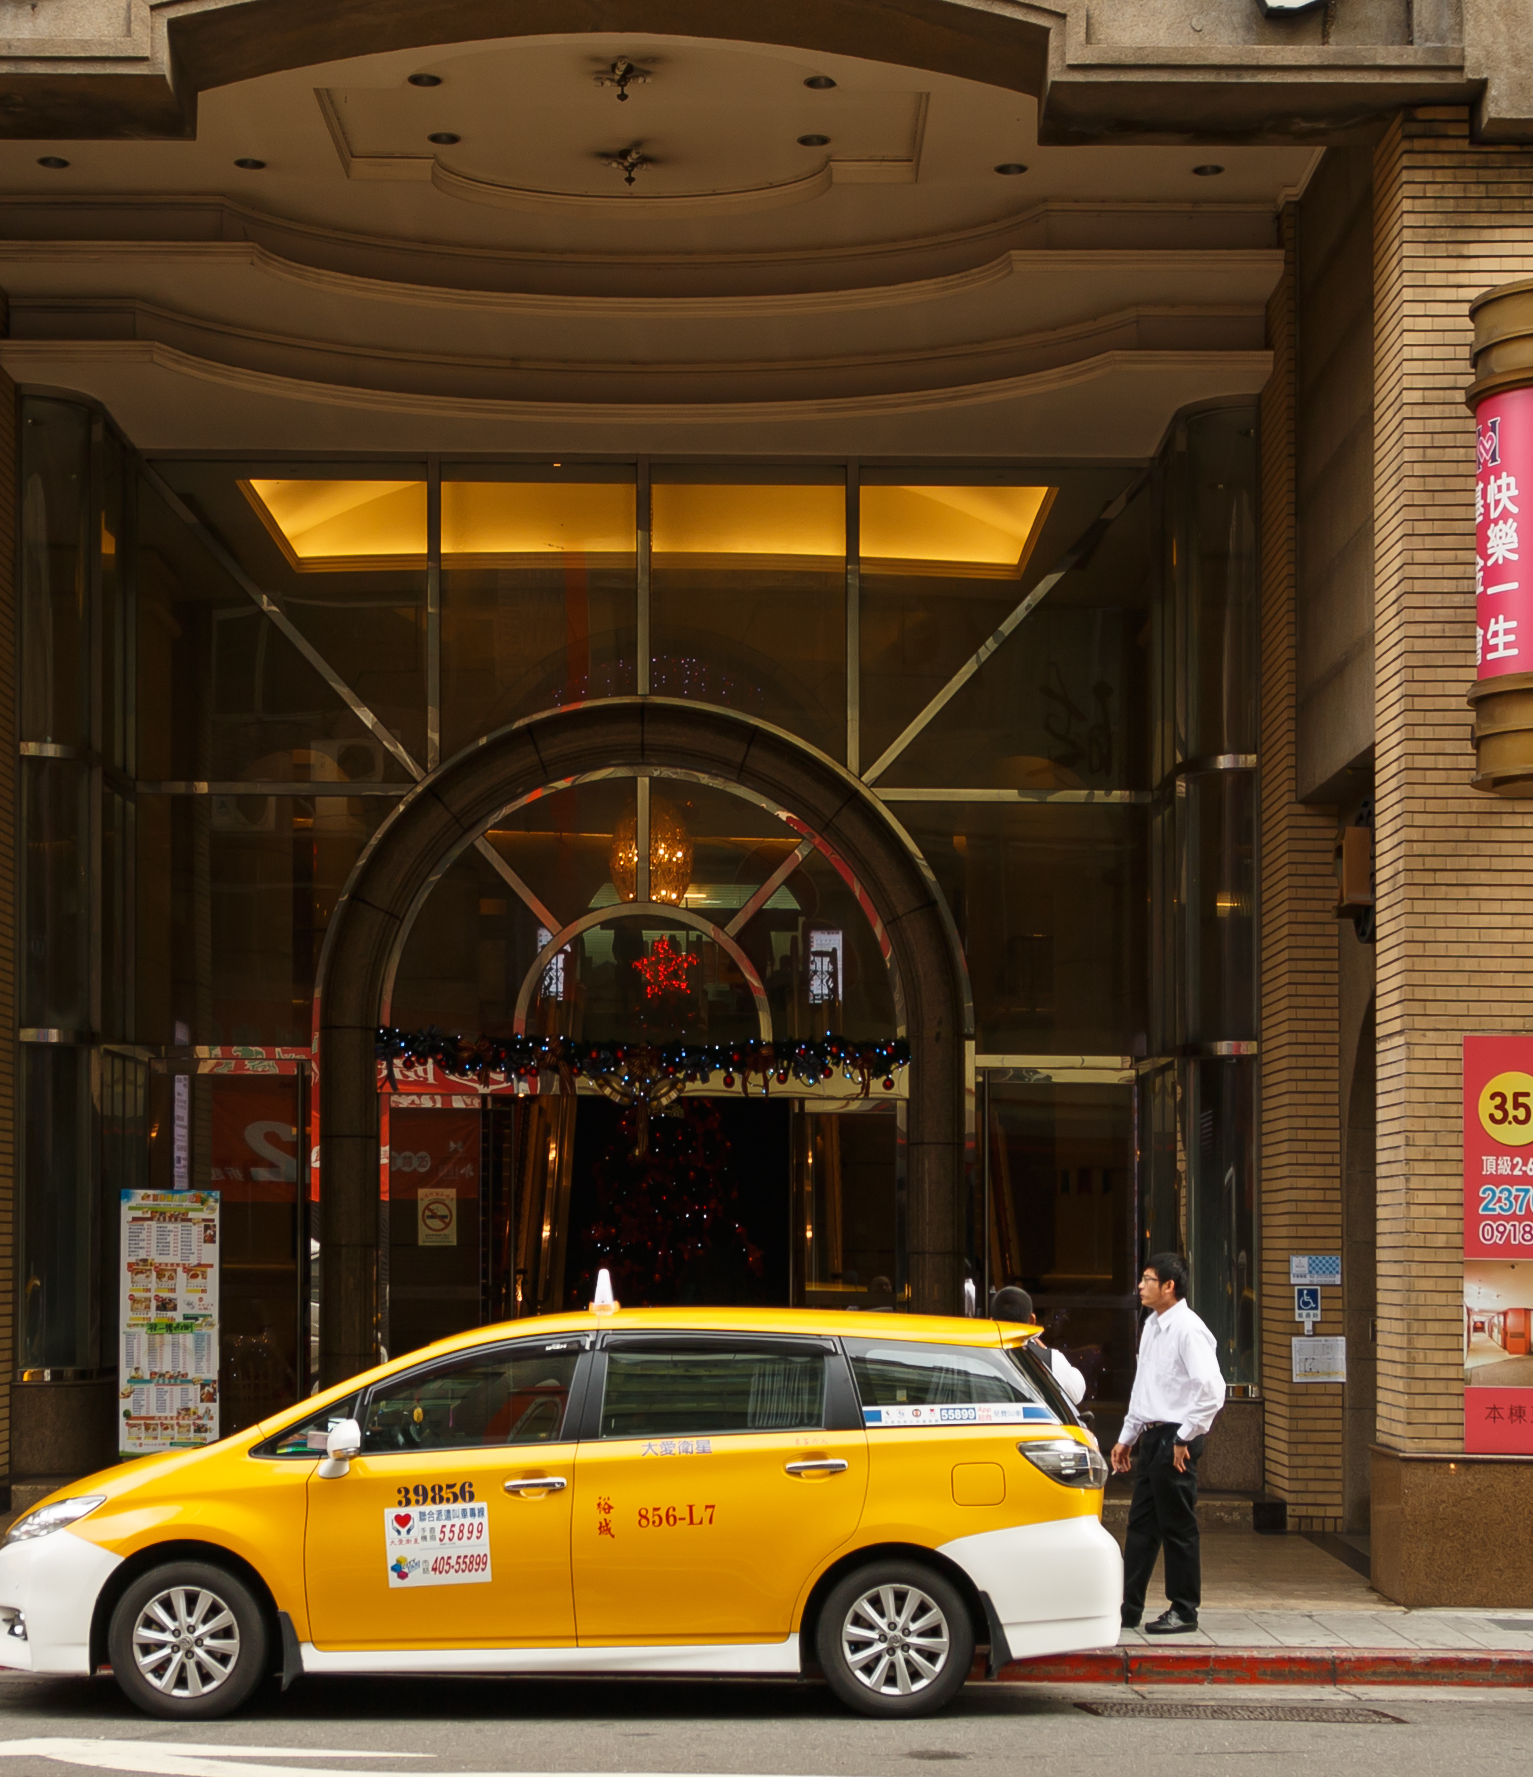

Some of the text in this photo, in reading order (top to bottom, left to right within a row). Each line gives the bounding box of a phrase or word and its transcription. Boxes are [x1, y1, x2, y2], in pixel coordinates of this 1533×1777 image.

[1486, 471, 1520, 661] 快樂一生
[941, 1408, 975, 1420] 55899
[641, 1439, 713, 1457] 大愛衛星
[396, 1480, 476, 1508] 39856
[637, 1503, 717, 1529] 856-L7
[438, 1521, 484, 1543] 55899
[431, 1553, 488, 1575] 405-55899
